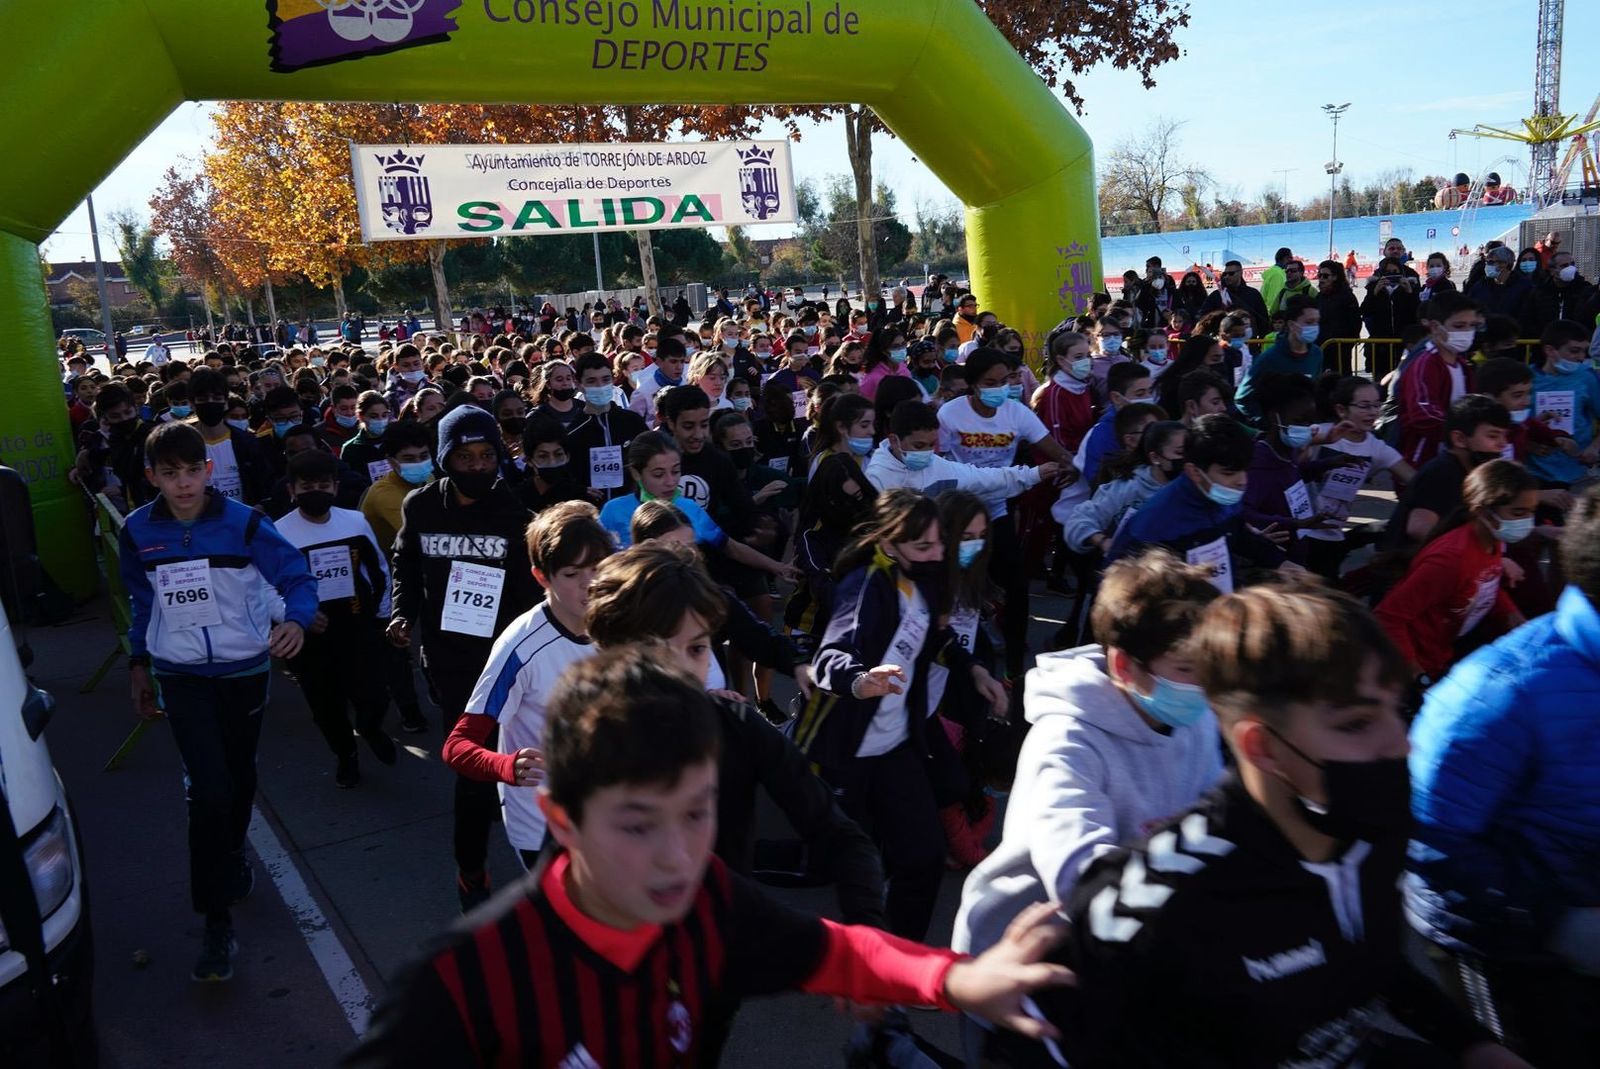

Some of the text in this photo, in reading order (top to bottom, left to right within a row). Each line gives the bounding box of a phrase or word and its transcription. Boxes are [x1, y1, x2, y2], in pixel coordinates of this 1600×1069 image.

[484, 0, 859, 40] Consejo Municipal de
[592, 39, 770, 72] DEPORTES
[472, 149, 707, 173] Ayuntamiento de TORREJÓN DE ARDOZ
[587, 177, 603, 189] de
[608, 177, 671, 191] Deportes
[457, 194, 715, 232] SALIDA
[34, 428, 54, 448] de
[593, 462, 620, 473] 6149
[1332, 473, 1361, 485] 6297
[421, 535, 507, 558] RECKLESS
[316, 566, 349, 581] 5476
[164, 587, 209, 606] 7696
[452, 589, 495, 610] 1782
